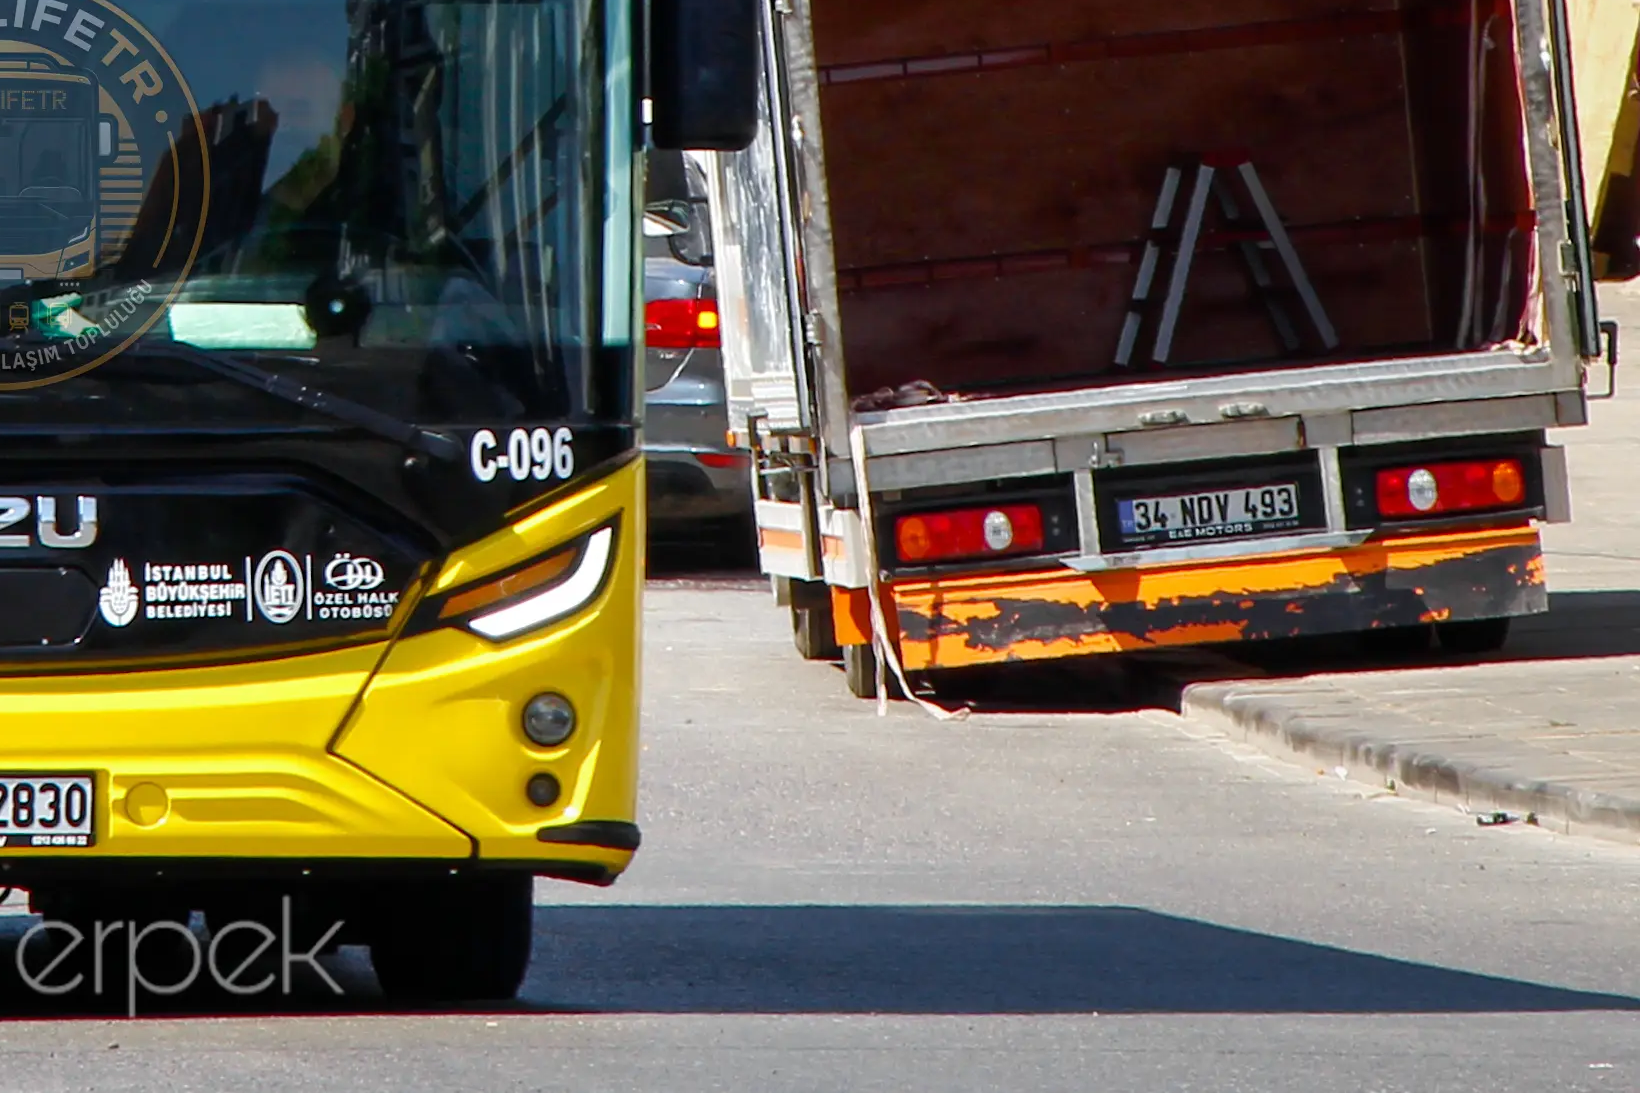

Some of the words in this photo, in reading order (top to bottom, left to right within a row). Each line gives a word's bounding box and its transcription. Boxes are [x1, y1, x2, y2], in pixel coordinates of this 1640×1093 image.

[471, 427, 574, 482] C-096
[1134, 501, 1168, 530] 34
[1245, 487, 1294, 518] 493
[1196, 523, 1252, 537] MOTORS
[145, 562, 232, 582] İSTANBUL
[314, 591, 353, 605] ÖZEL
[357, 591, 398, 604] HALK
[146, 602, 232, 619] BELEDİYESİ
[319, 605, 393, 620] OTOBÜSÜ
